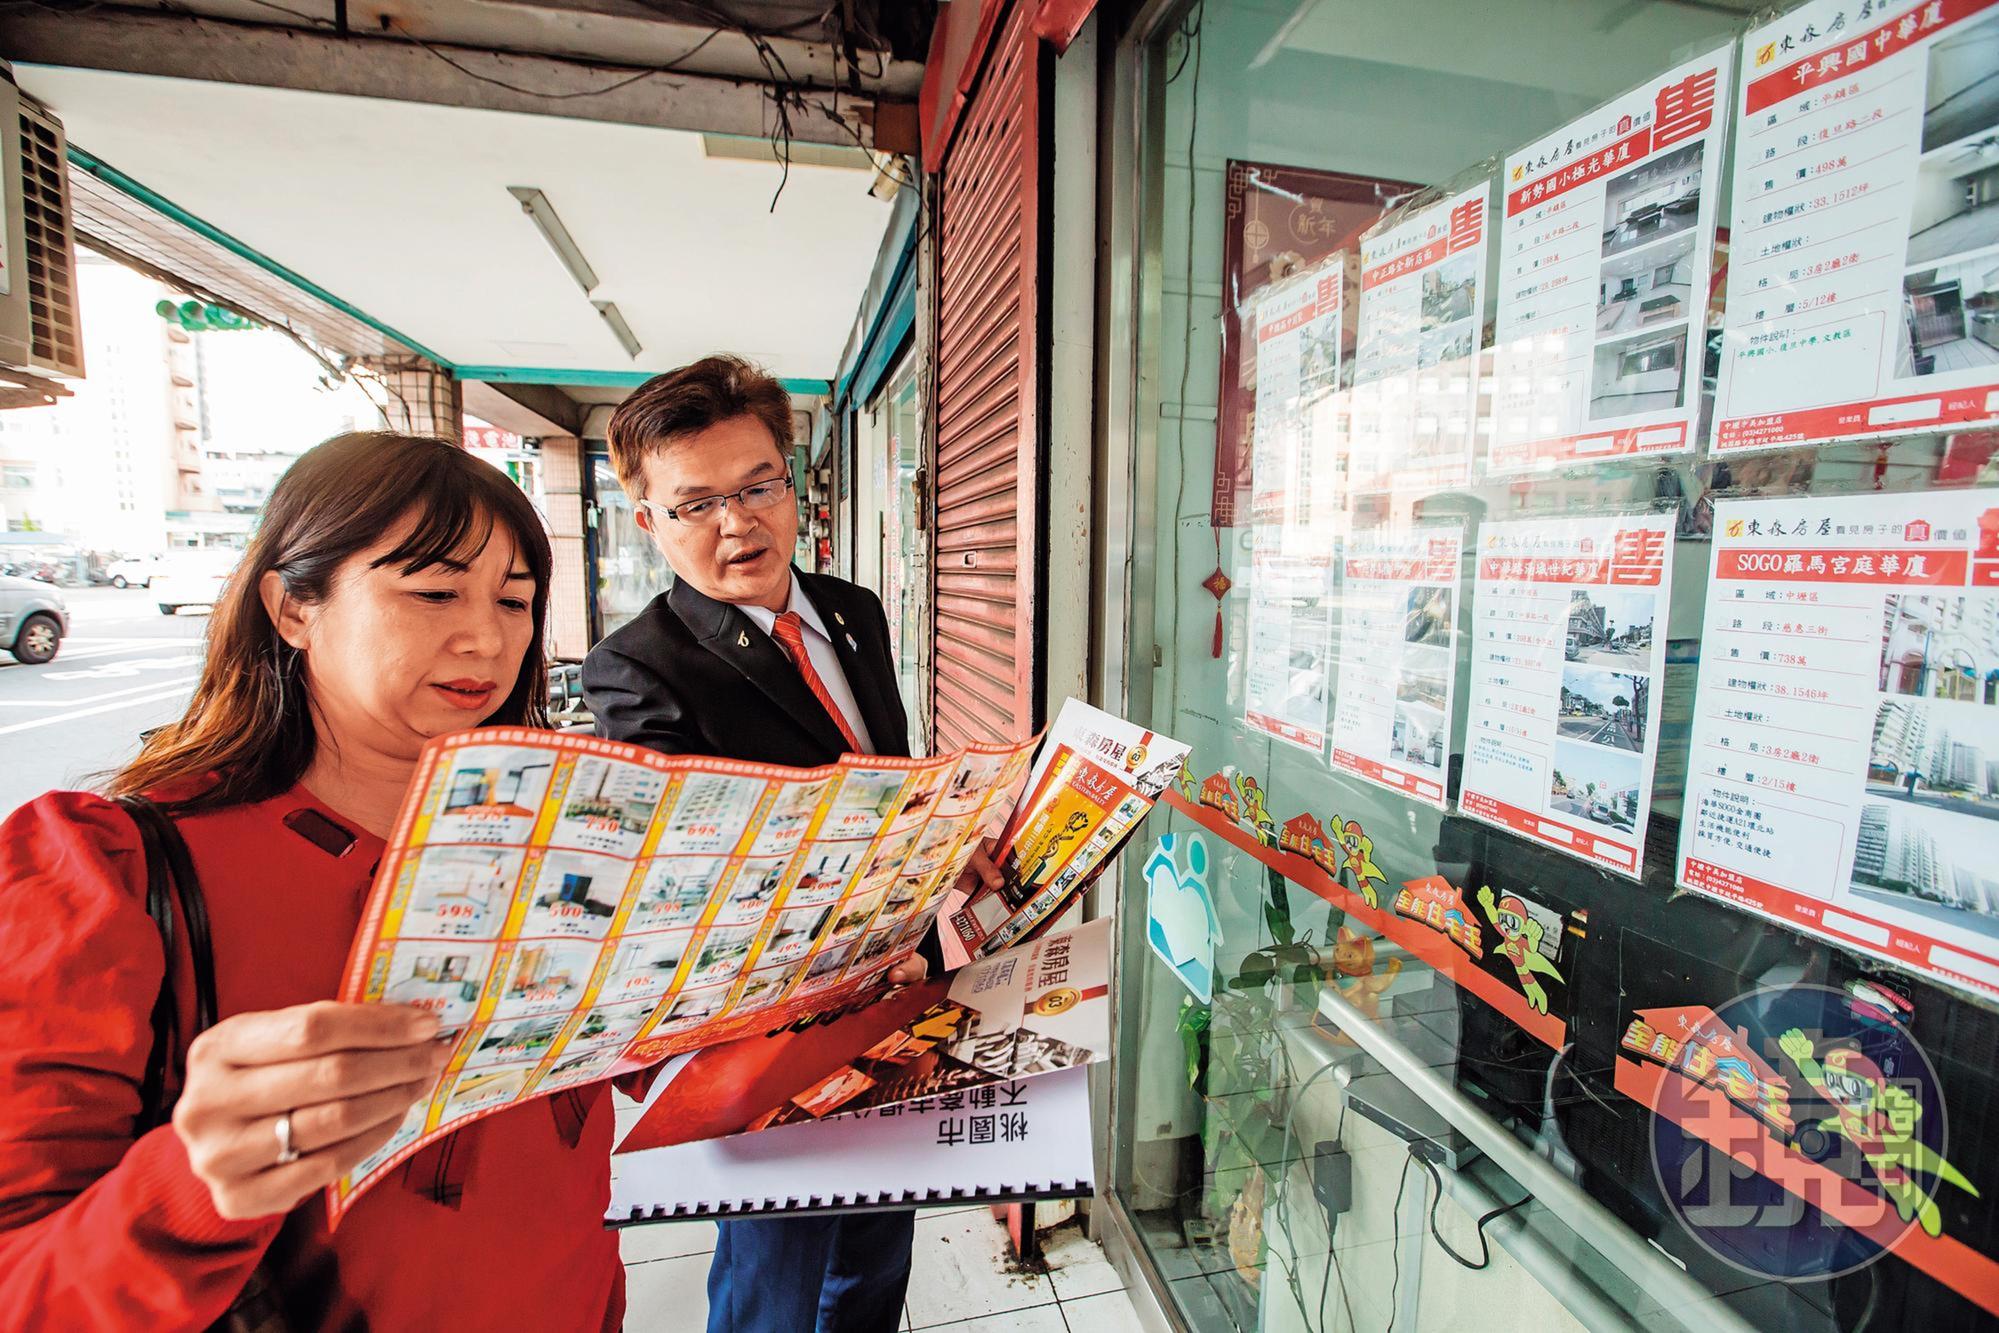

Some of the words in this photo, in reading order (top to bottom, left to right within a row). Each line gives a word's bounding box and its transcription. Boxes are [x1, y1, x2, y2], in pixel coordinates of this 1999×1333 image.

[1793, 0, 1946, 85] 平興國中華廈
[1653, 67, 1718, 152] 售
[1449, 197, 1483, 255] 售
[1746, 517, 1832, 537] 東森房屋
[1612, 528, 1667, 586] 售
[1737, 553, 1930, 579] SOGO羅馬宮庭華廈
[936, 1111, 1028, 1147] 桃園市
